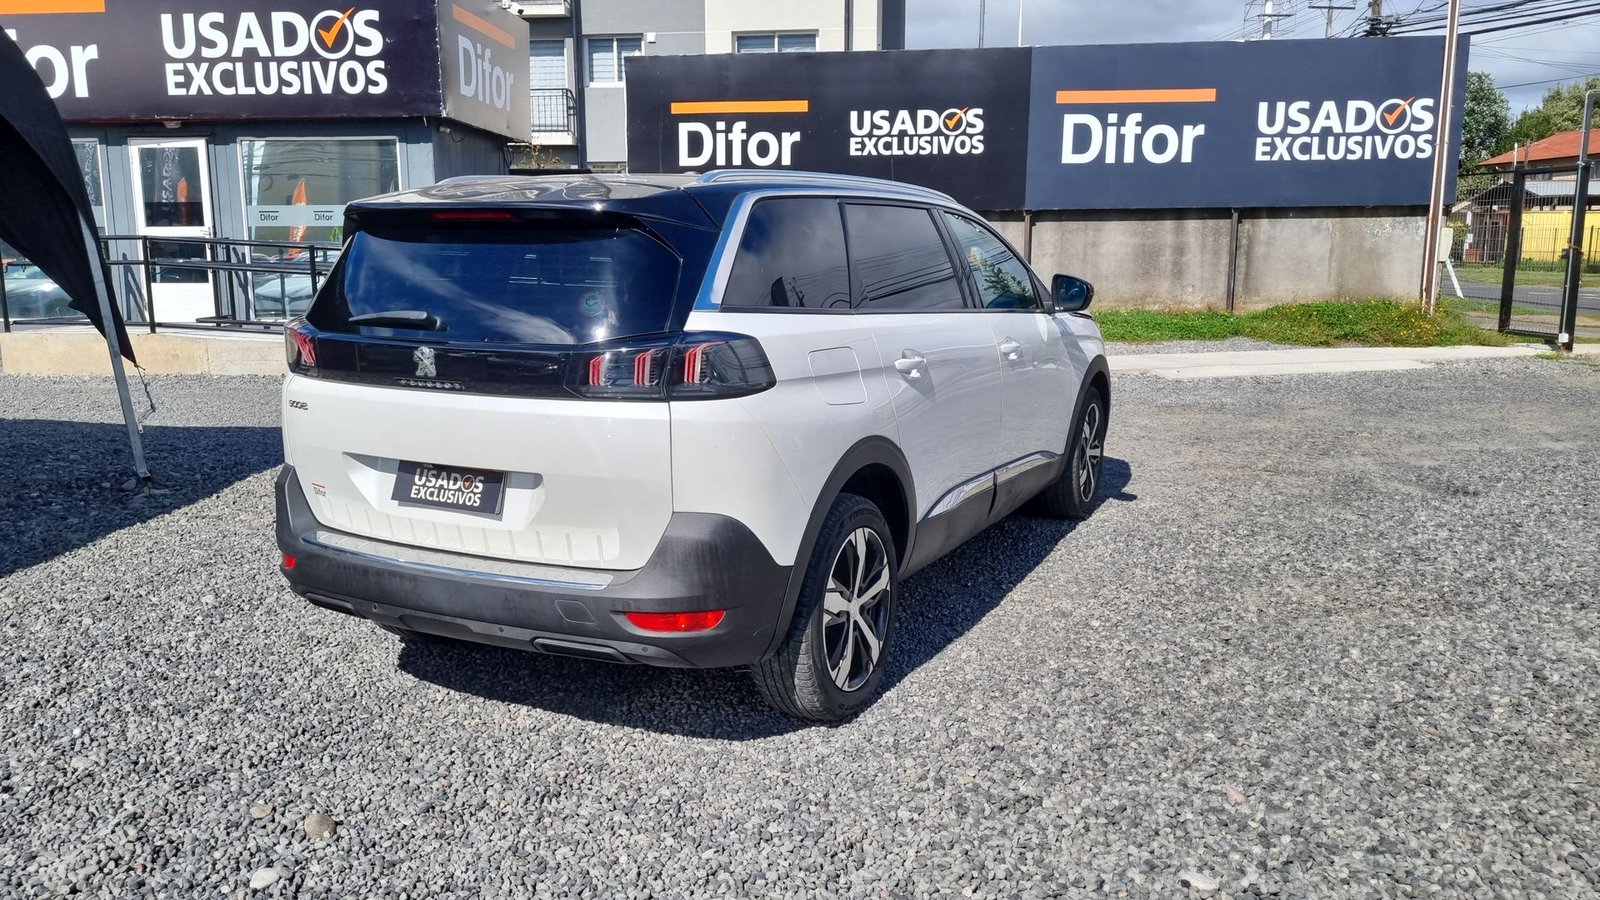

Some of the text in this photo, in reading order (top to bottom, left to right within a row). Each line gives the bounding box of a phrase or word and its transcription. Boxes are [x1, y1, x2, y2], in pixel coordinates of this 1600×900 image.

[160, 8, 385, 60] USADOS
[4, 28, 99, 99] or
[166, 60, 389, 96] EXCLUSIVOS
[457, 34, 514, 112] Difor
[849, 107, 985, 136] USADOS
[1257, 97, 1434, 134] USADOS
[678, 121, 801, 167] Difor
[849, 135, 985, 156] EXCLUSIVOS
[1061, 112, 1205, 165] Difor
[1254, 133, 1433, 161] EXCLUSIVOS
[260, 213, 279, 221] Difor
[314, 213, 333, 221] Difor
[410, 485, 482, 507] EXCLUSIVOS
[414, 468, 485, 493] USADOS
